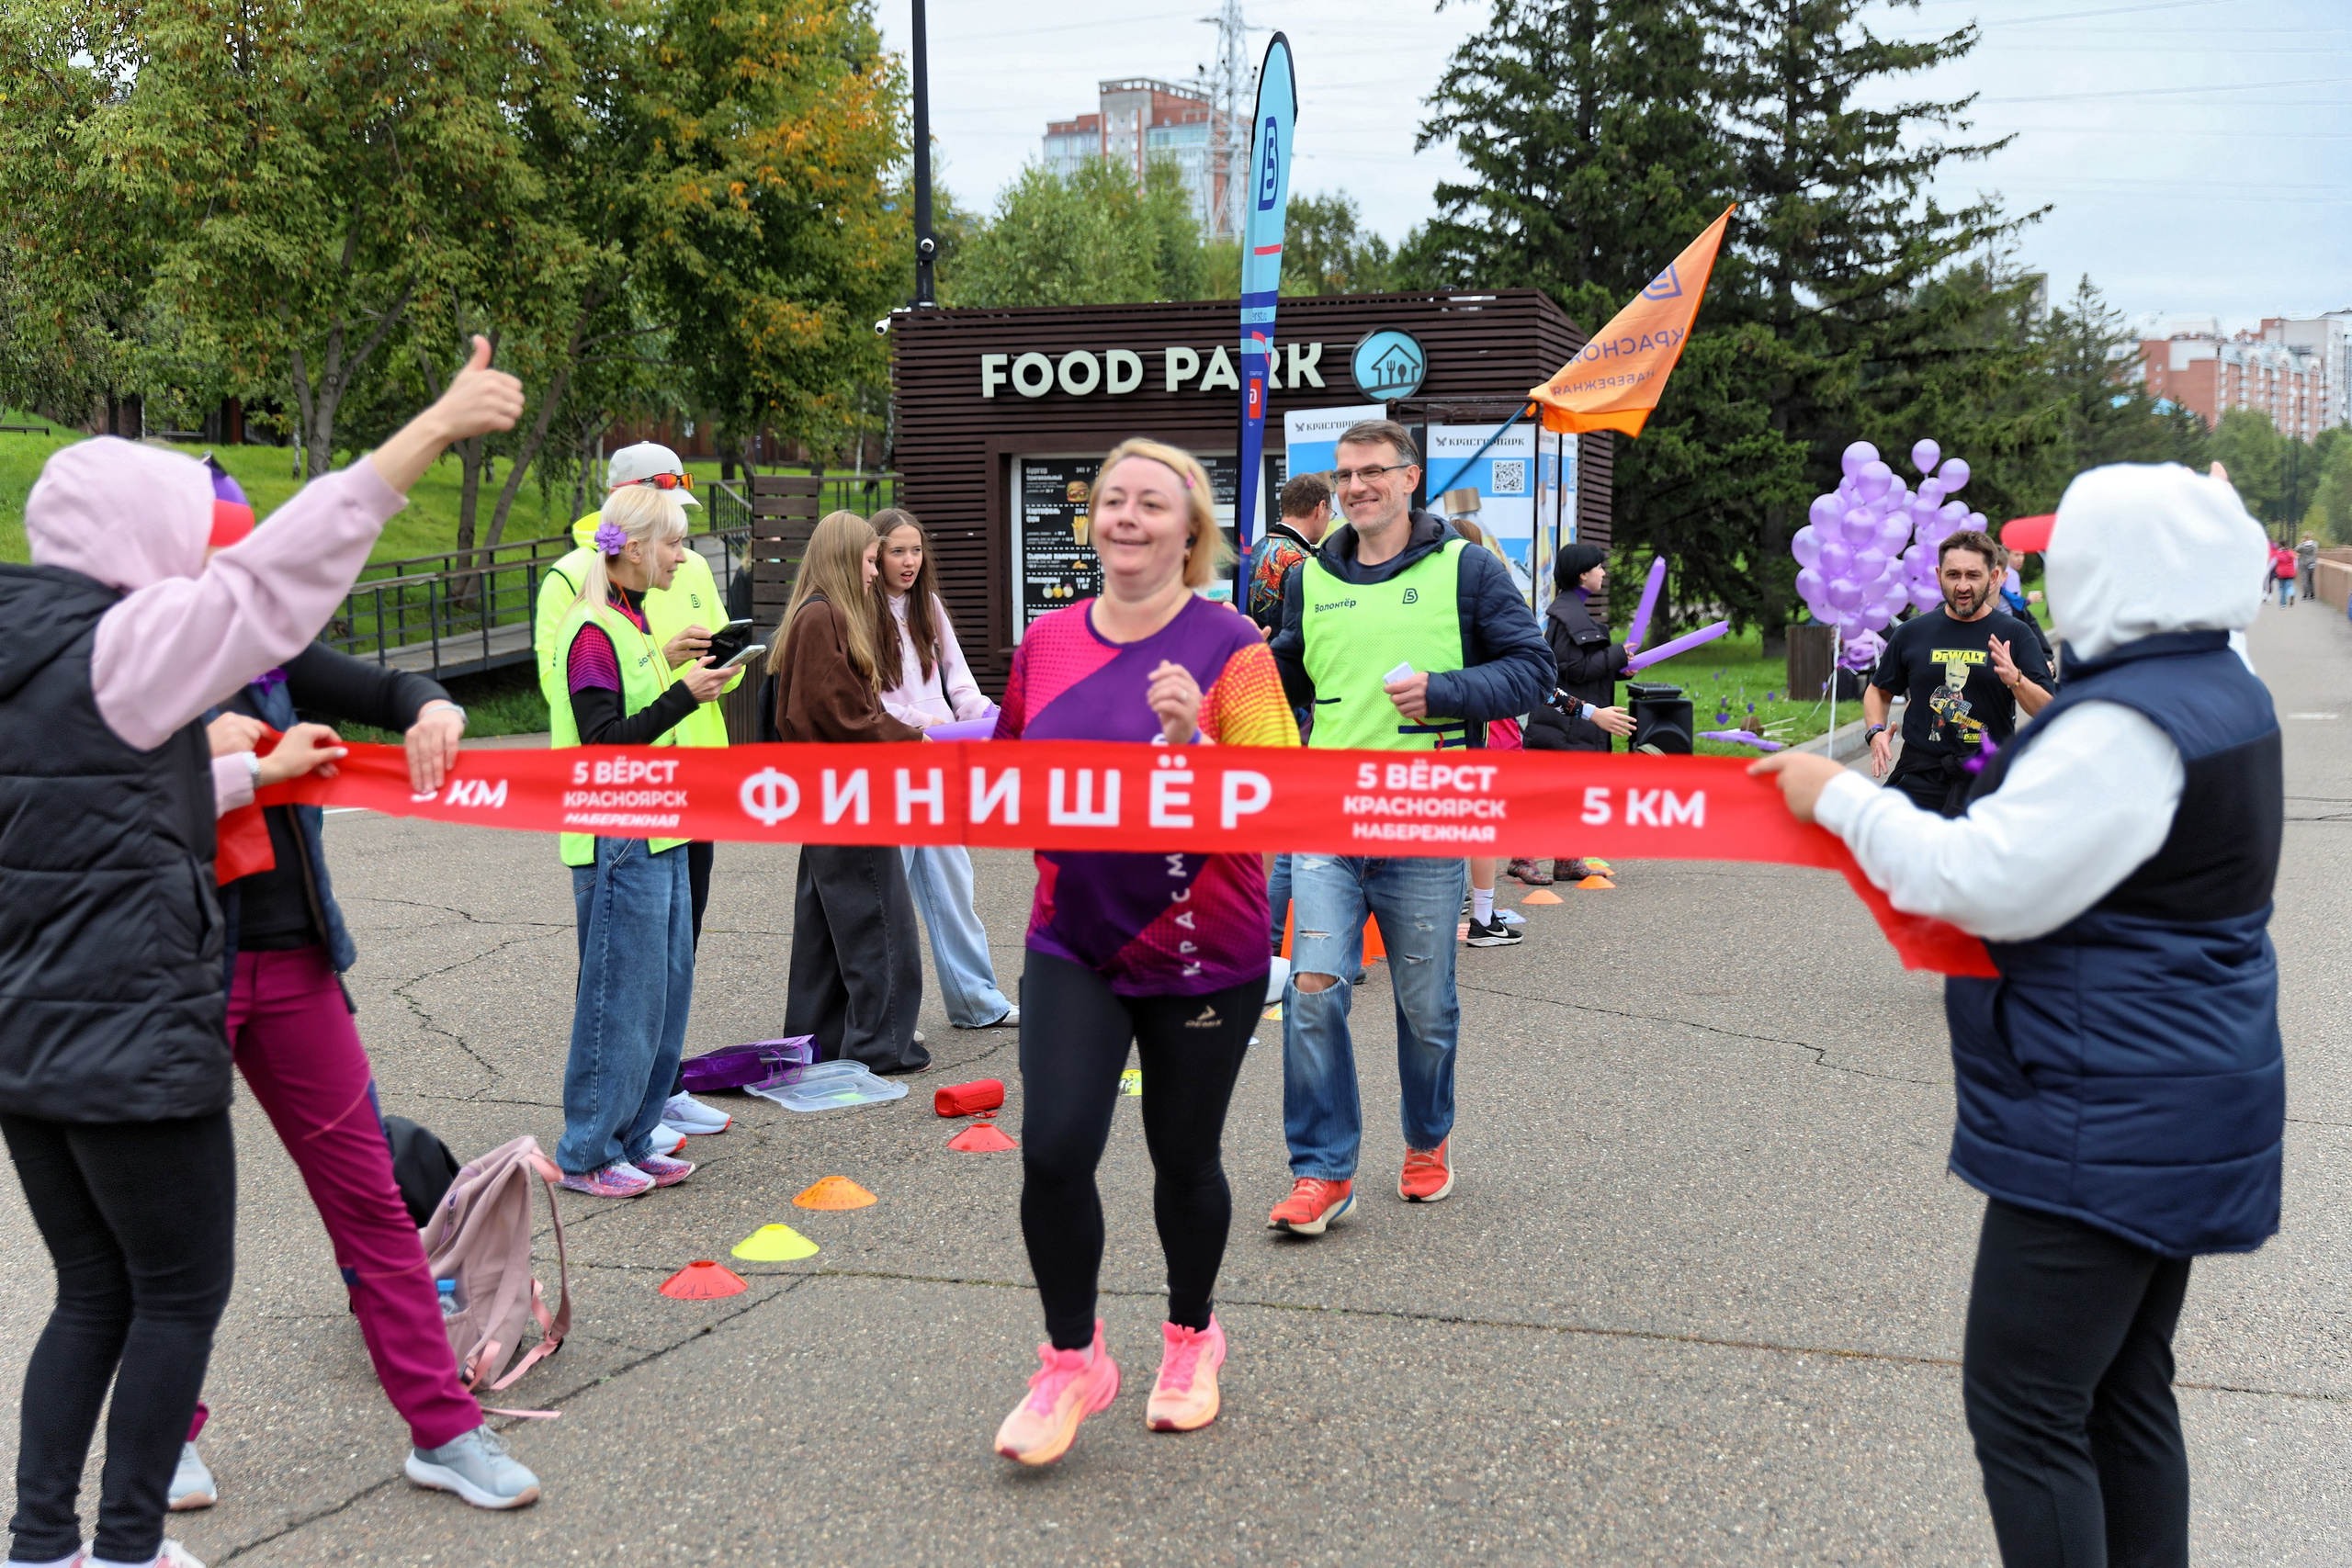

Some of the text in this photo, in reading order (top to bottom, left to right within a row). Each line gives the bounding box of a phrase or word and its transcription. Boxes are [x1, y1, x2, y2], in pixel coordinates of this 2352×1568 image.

[981, 349, 1144, 398] FOOD
[1315, 598, 1356, 613] Волонтёр
[573, 756, 679, 784] 5 ВЁРСТ
[1356, 759, 1498, 792] 5 ВЁРСТ
[563, 790, 688, 808] КРАСНОЯРСК
[739, 754, 1272, 829] ФИНИШЁР
[1343, 795, 1507, 819] КРАСНОЯРСК
[1580, 786, 1611, 825] 5
[564, 813, 681, 828] НАБЕРЕЖНАЯ
[1352, 822, 1496, 842] НАБЕРЕЖНАЯ
